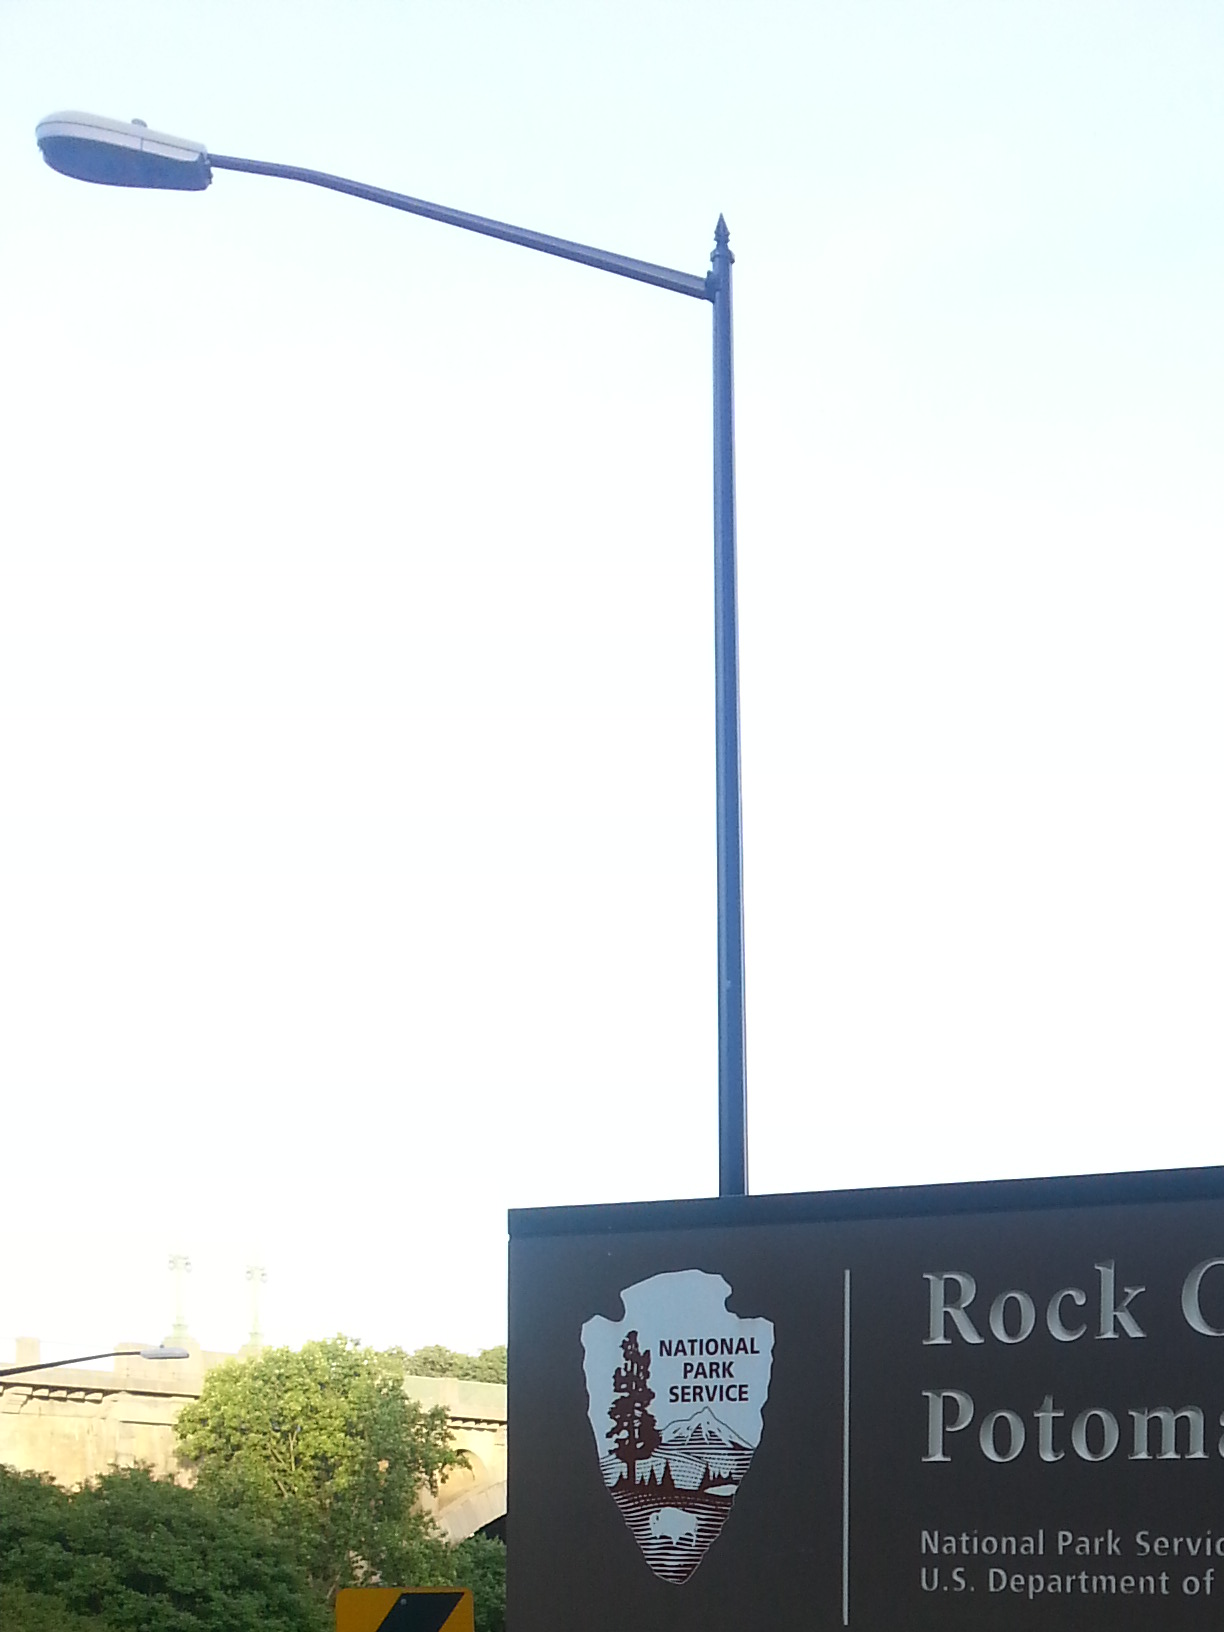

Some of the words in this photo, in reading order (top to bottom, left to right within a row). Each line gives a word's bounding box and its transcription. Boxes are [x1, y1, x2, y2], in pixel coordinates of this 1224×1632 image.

[921, 1260, 1148, 1345] Rock
[658, 1337, 761, 1357] NATIONAL
[682, 1360, 735, 1380] PARK
[668, 1384, 750, 1403] SERVICE
[921, 1528, 1045, 1556] National
[1057, 1528, 1122, 1556] Park
[921, 1567, 976, 1592] U.S.
[988, 1567, 1171, 1600] Department
[1182, 1568, 1216, 1595] of
